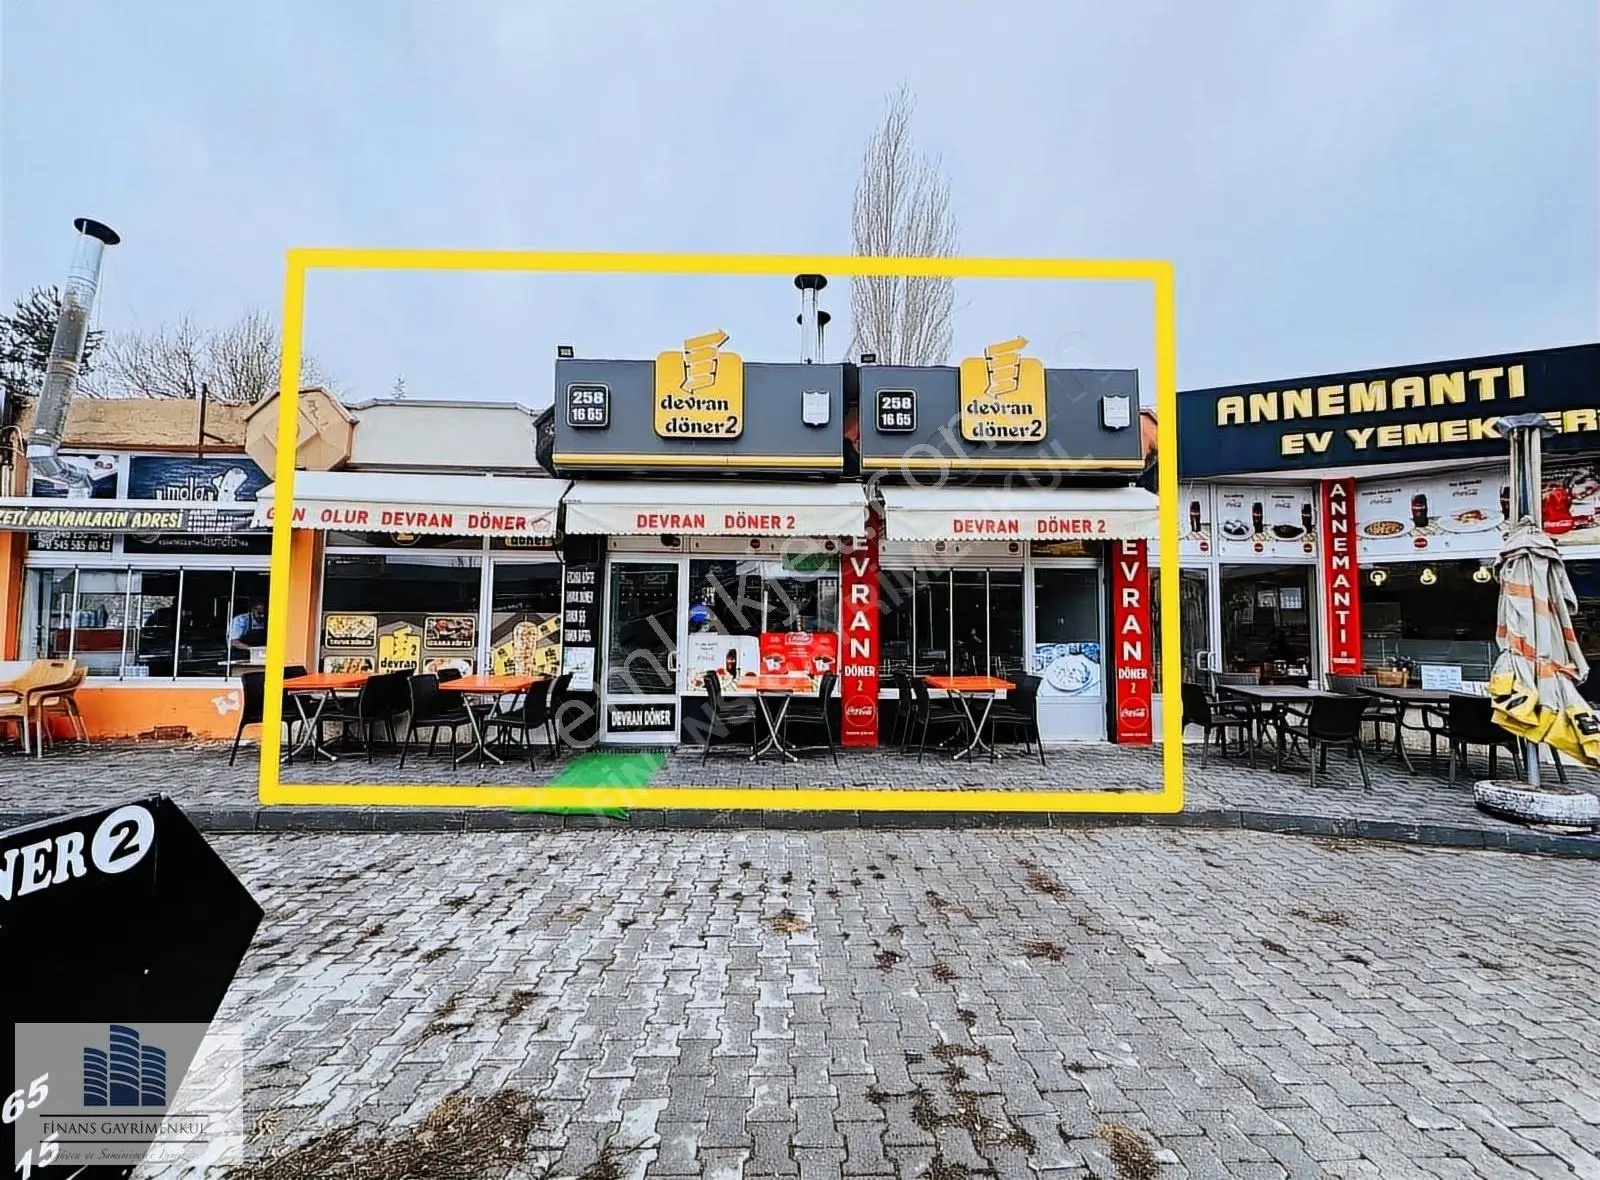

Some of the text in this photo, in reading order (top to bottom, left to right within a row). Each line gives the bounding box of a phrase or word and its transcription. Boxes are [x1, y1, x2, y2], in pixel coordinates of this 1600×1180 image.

[572, 391, 604, 405] 258
[660, 395, 729, 411] devran
[881, 397, 912, 410] 258
[1217, 364, 1525, 426] ANNEMANTI
[966, 400, 1033, 415] devran
[1281, 408, 1600, 456] EV YEMEKER
[27, 510, 129, 527] ARAYANLARIN
[131, 509, 184, 528] ADRESİ
[266, 507, 527, 531] GN OLUR DEVRAN DÖNER
[637, 512, 796, 529] DEVRAN DÖNER 2
[953, 516, 1106, 534] DEVRAN DÖNER 2
[1330, 483, 1351, 643] ANNEMANTI
[850, 536, 871, 659] EVRAN
[1120, 539, 1143, 662] EVRAN
[380, 657, 418, 668] devran
[844, 664, 876, 677] DÖNER
[1118, 667, 1148, 680] DÖNER
[611, 706, 671, 727] DEVRAN DÖNER
[108, 819, 141, 864] 2
[1, 1072, 49, 1124] 65
